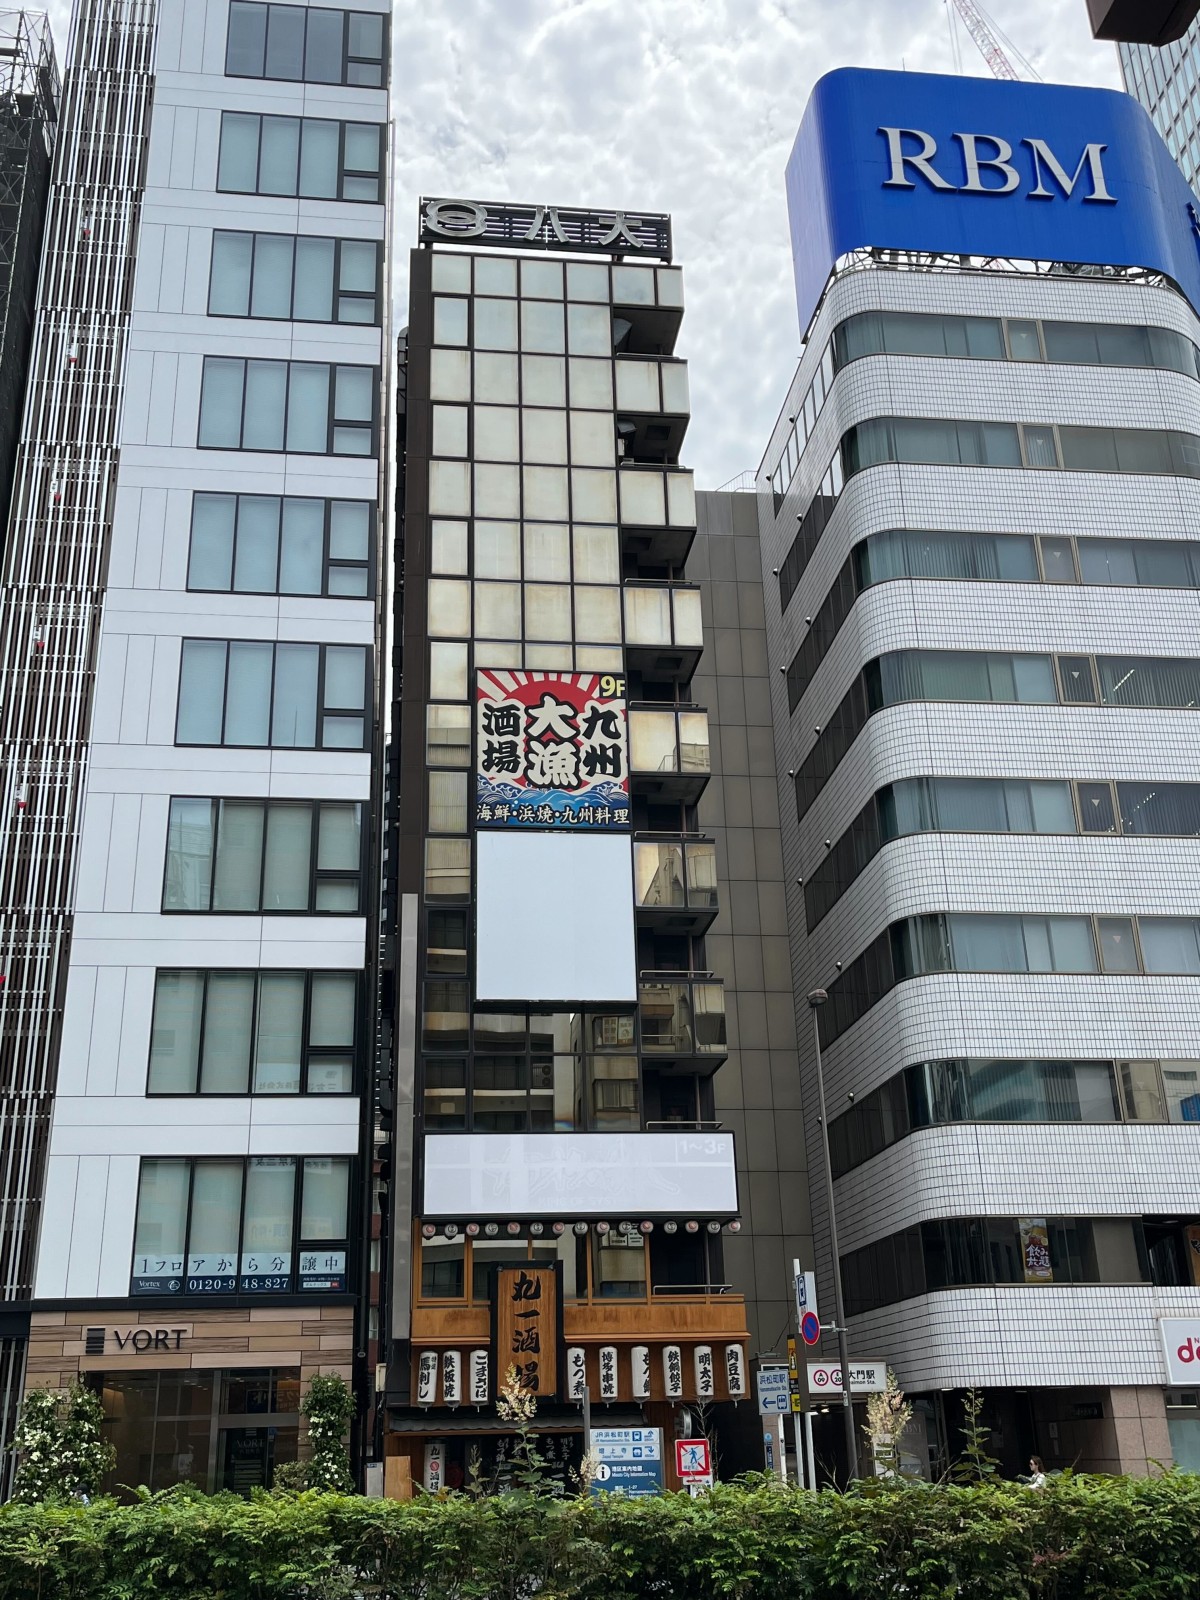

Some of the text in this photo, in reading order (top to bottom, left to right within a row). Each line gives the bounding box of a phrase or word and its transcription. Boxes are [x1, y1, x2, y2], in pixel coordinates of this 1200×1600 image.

[878, 127, 1118, 204] RBM
[600, 675, 626, 697] 9F
[481, 702, 522, 774] 酒場
[524, 692, 580, 789] 大漁
[582, 705, 623, 778] 九州
[476, 803, 631, 825] 海鮮・浜焼・九州料理
[1026, 1243, 1049, 1257] 飲み
[1026, 1256, 1051, 1268] 放題
[139, 1280, 161, 1288] Vortex
[189, 1277, 289, 1290] 0120-948-827
[114, 1329, 188, 1350] VORT
[511, 1270, 542, 1391] 丸一酒場
[1177, 1338, 1200, 1363] d
[419, 1356, 431, 1399] 馬刺し
[444, 1354, 456, 1398] 鉄板焼
[475, 1353, 488, 1398] ごまさば
[572, 1353, 585, 1396] もつ煮
[602, 1351, 615, 1395] 博多串焼
[668, 1350, 681, 1393] 鉄鍋餃子
[698, 1352, 712, 1392] 明太子
[727, 1349, 741, 1391] 肉豆腐
[760, 1373, 786, 1385] 浜松町駅
[849, 1369, 875, 1380] 大門駅
